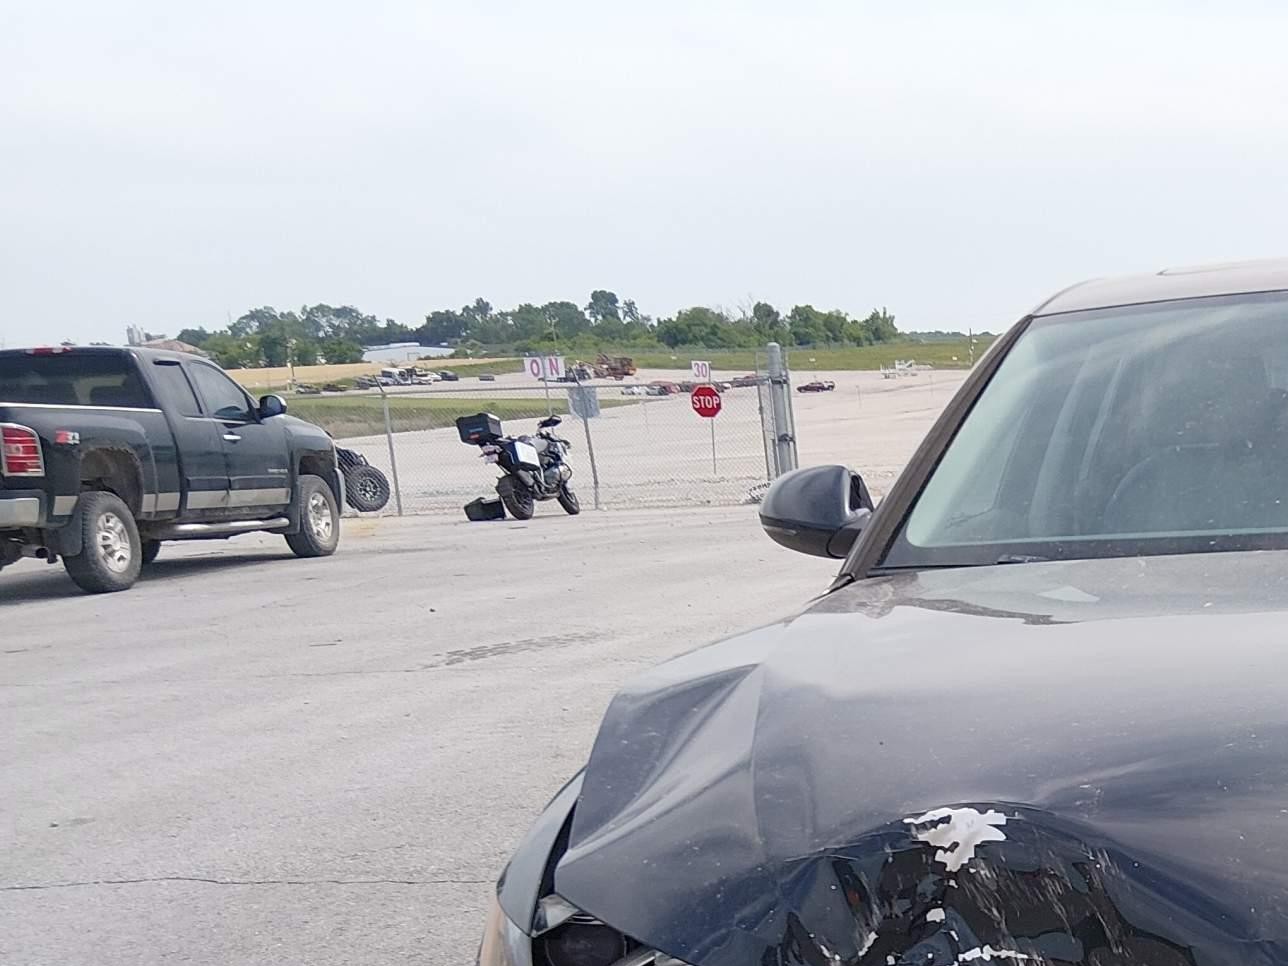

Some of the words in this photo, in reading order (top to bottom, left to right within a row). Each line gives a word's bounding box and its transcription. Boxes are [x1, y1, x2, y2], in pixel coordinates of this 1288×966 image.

[548, 357, 560, 376] N
[693, 362, 708, 378] 30
[692, 395, 720, 409] STOP
